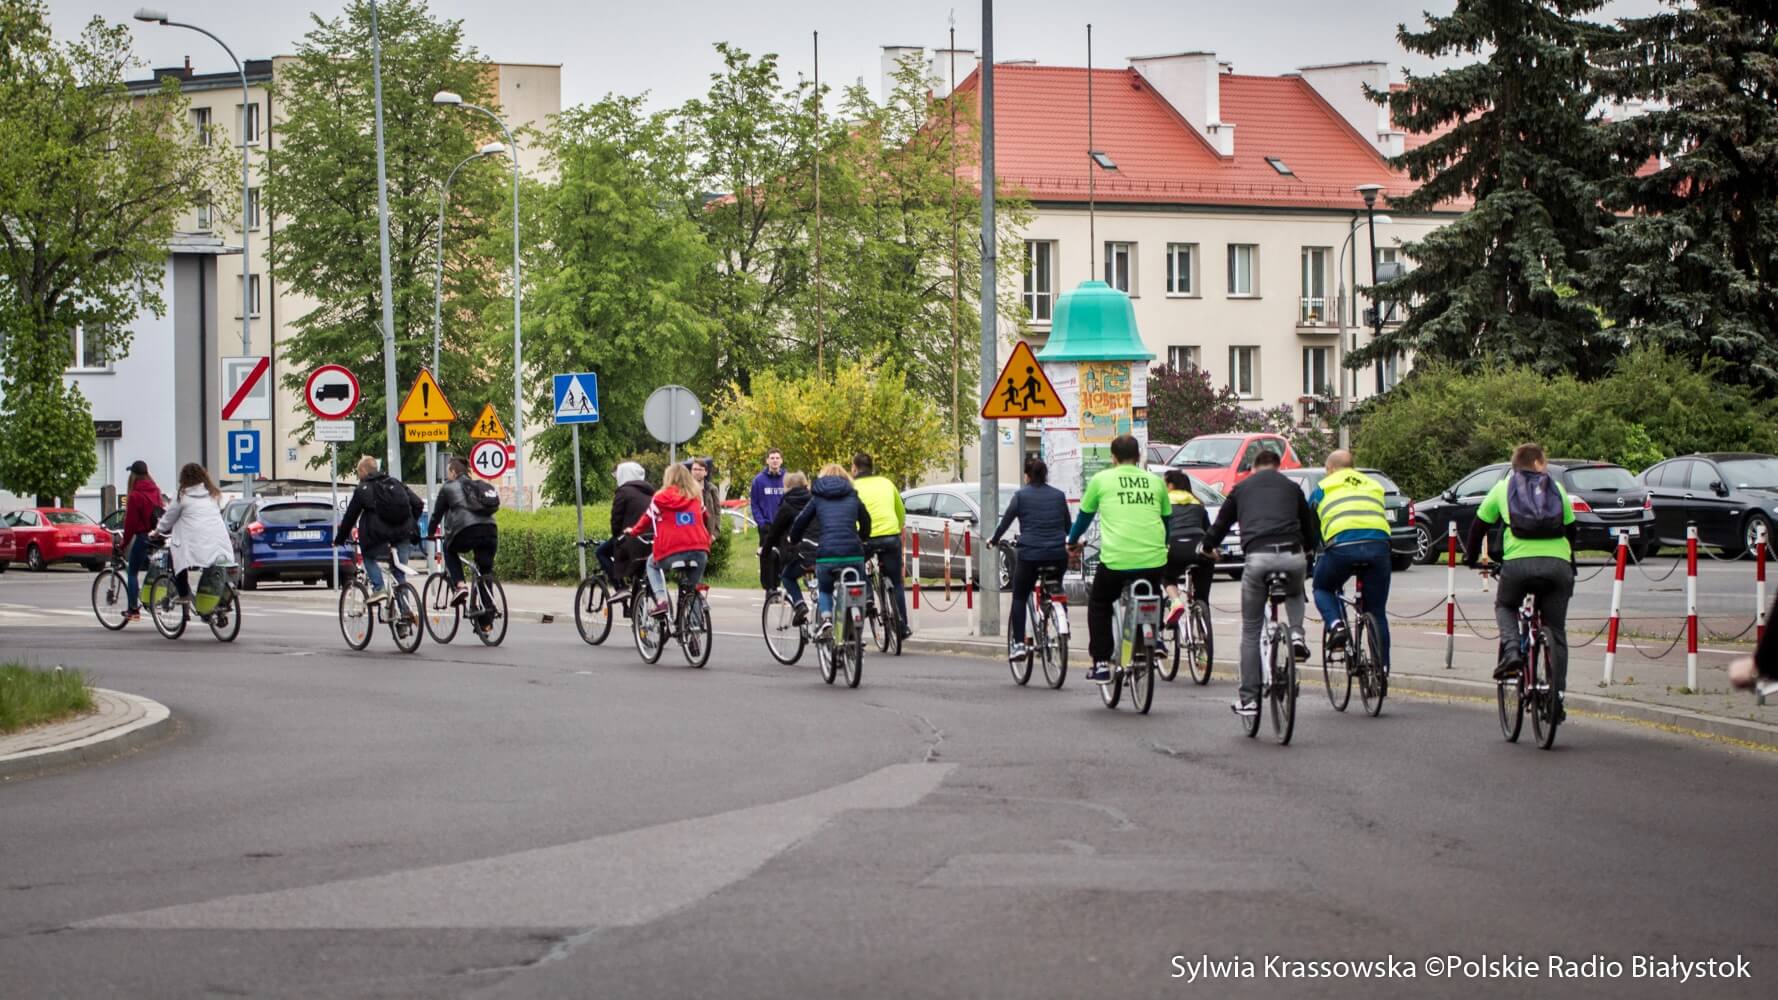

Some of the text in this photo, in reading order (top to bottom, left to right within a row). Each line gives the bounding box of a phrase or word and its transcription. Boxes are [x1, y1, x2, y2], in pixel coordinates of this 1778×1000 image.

[408, 428, 447, 439] Wypadki
[235, 434, 254, 461] P
[476, 451, 504, 469] 40
[1118, 476, 1149, 488] UMB
[1117, 491, 1154, 505] TEAM
